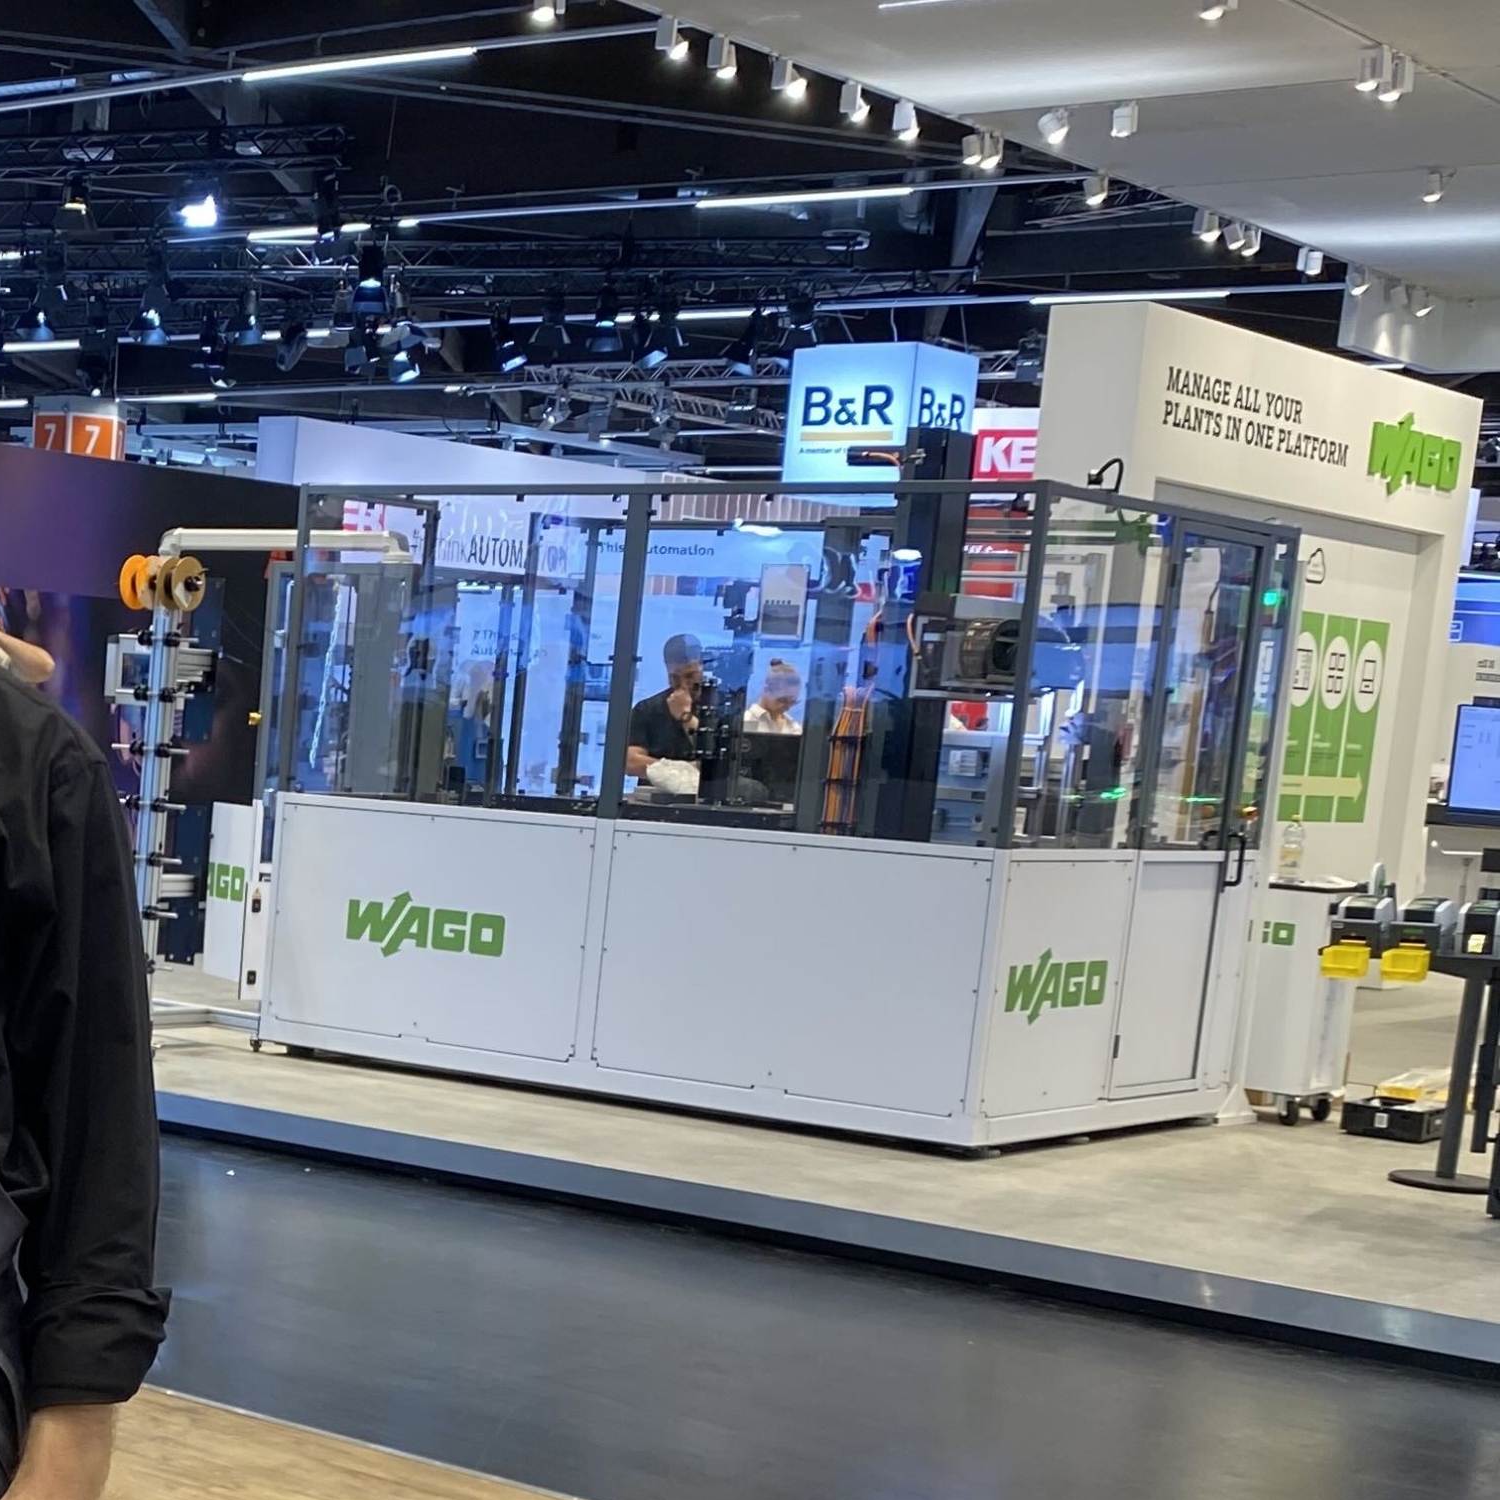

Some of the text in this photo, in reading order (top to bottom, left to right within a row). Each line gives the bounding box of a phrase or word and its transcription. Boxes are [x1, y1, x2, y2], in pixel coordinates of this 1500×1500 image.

[801, 385, 895, 427] B&R
[918, 386, 966, 431] B&R
[1166, 366, 1303, 424] MANAGE ALL YOUR
[44, 423, 57, 451] 7
[85, 424, 101, 454] 7
[1162, 400, 1349, 467] PLANTS IN ONE PLATFORM
[1367, 411, 1462, 497] WAGO
[346, 890, 506, 957] WAGO
[1004, 947, 1108, 1026] WAGO
